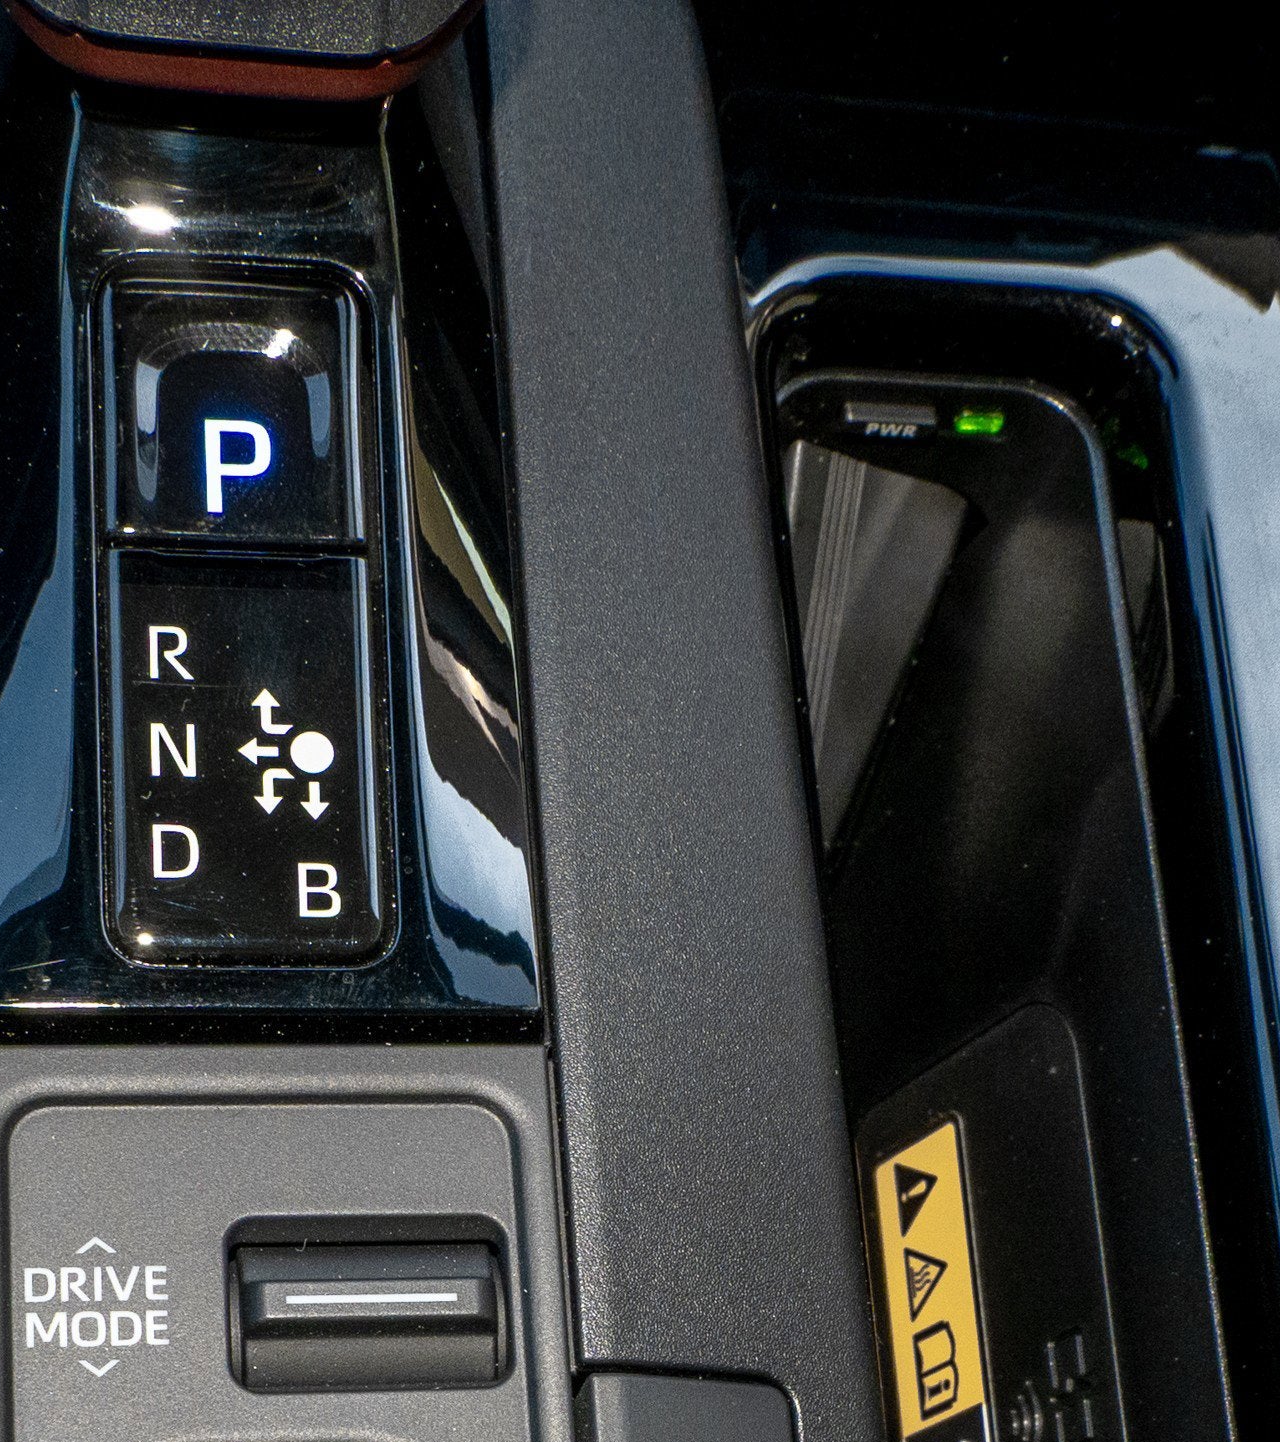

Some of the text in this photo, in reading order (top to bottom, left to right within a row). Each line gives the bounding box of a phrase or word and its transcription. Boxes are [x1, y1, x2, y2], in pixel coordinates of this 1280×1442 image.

[865, 421, 918, 438] PWR
[204, 418, 272, 514] P
[148, 625, 195, 681] R
[150, 723, 197, 778] N
[151, 823, 201, 879] D
[296, 862, 342, 918] B
[24, 1265, 169, 1303] DRIVE
[25, 1309, 170, 1348] MODE
